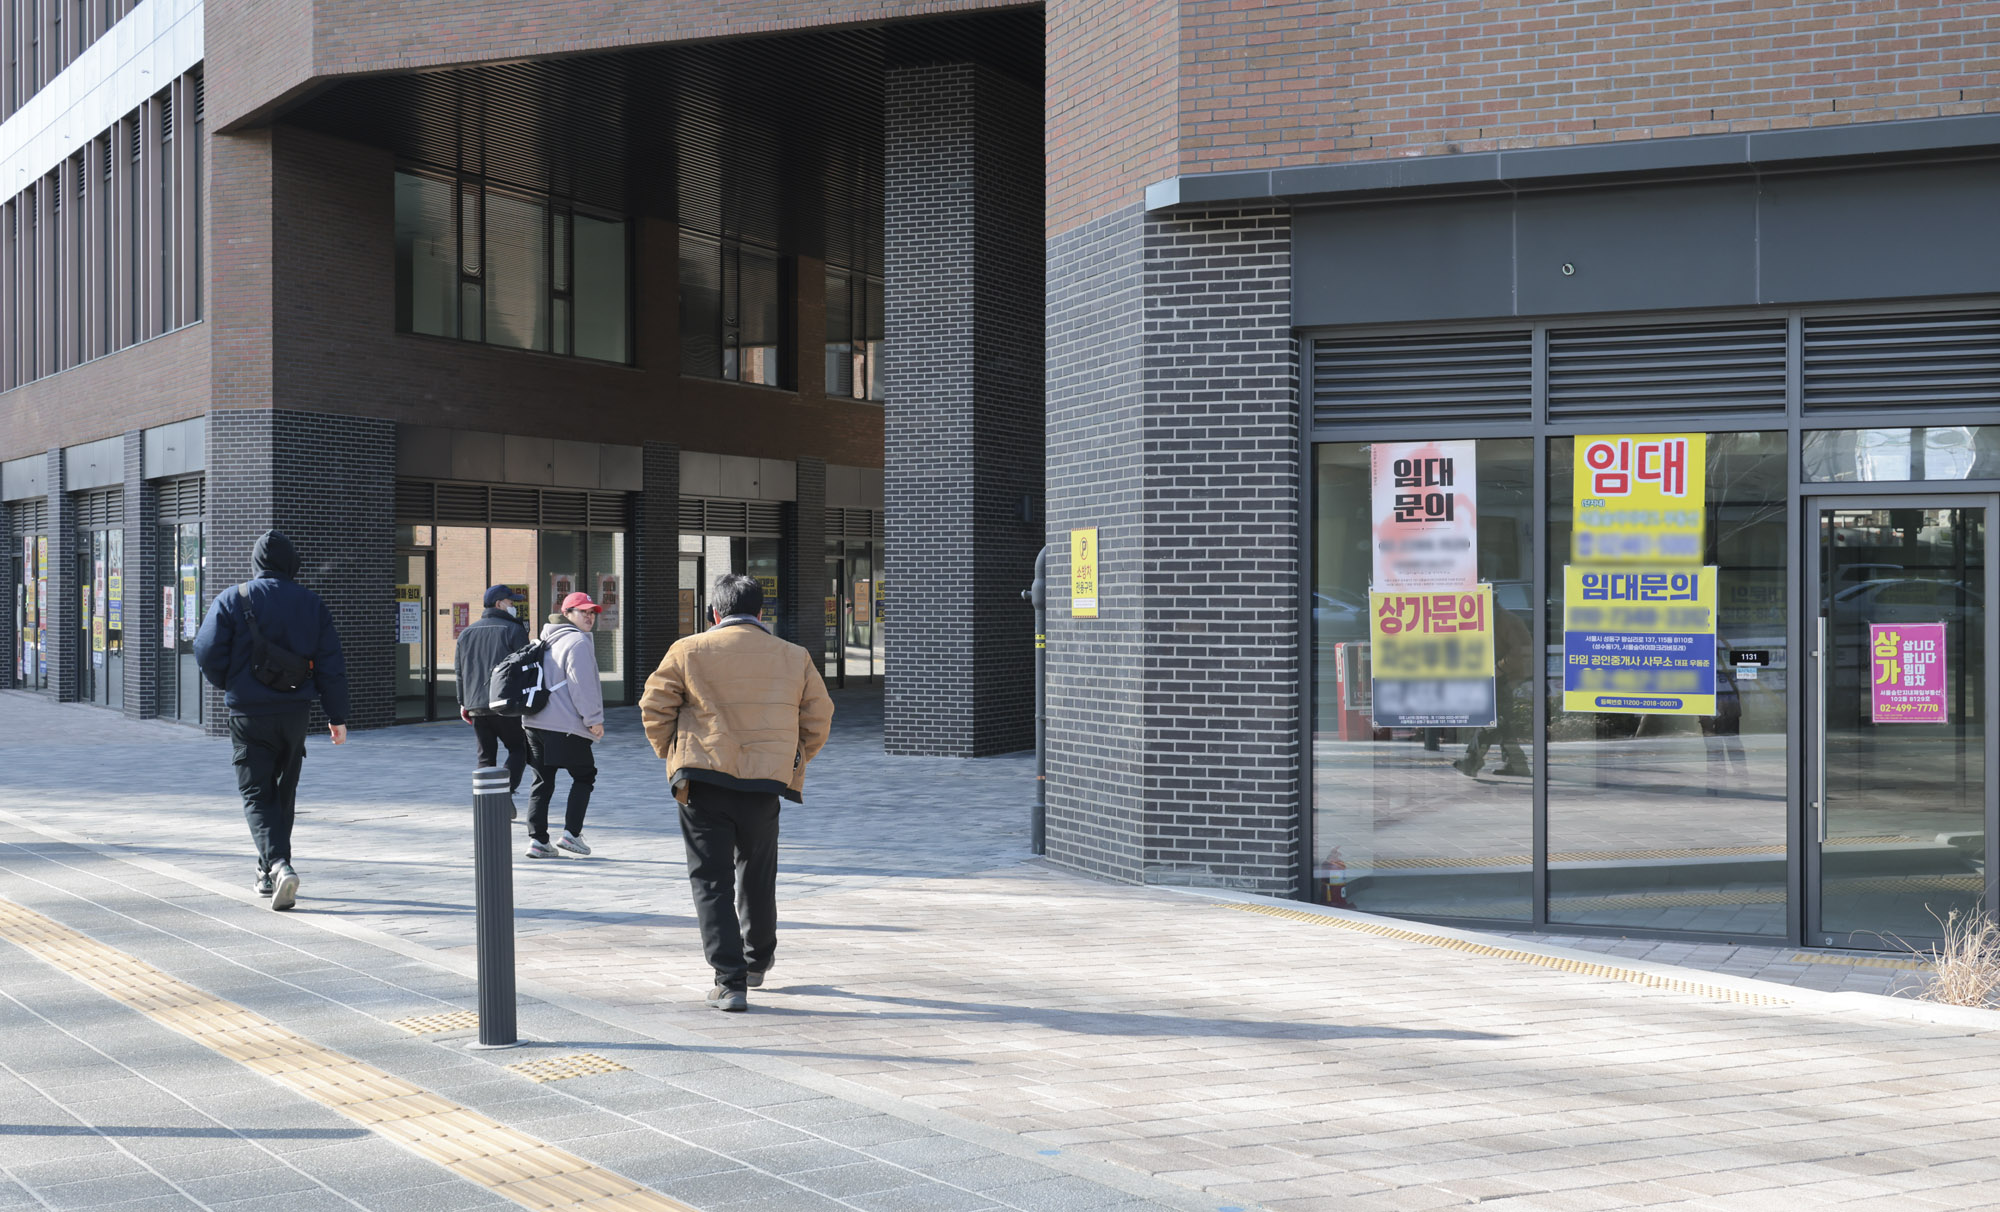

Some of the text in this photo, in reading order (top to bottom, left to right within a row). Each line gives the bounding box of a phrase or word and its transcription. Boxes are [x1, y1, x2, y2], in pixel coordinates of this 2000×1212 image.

[1394, 458, 1454, 488] 임대
[1585, 439, 1686, 496] 임대
[1393, 493, 1454, 523] 문의
[1077, 565, 1092, 579] 소방차
[1582, 574, 1698, 601] 임대문의
[1379, 594, 1485, 634] 상가문의
[1903, 640, 1936, 651] 삽니다
[1569, 654, 1588, 665] 타임
[1591, 654, 1640, 666] 공인중개사
[1642, 656, 1673, 667] 사무소
[1675, 659, 1688, 667] 대표
[1741, 653, 1757, 661] 1131
[1874, 632, 1901, 684] 상가
[1903, 652, 1937, 664] 팝니다
[1904, 664, 1925, 675] 임대
[1904, 675, 1926, 687] 임차
[1880, 703, 1939, 712] 02-499-7770
